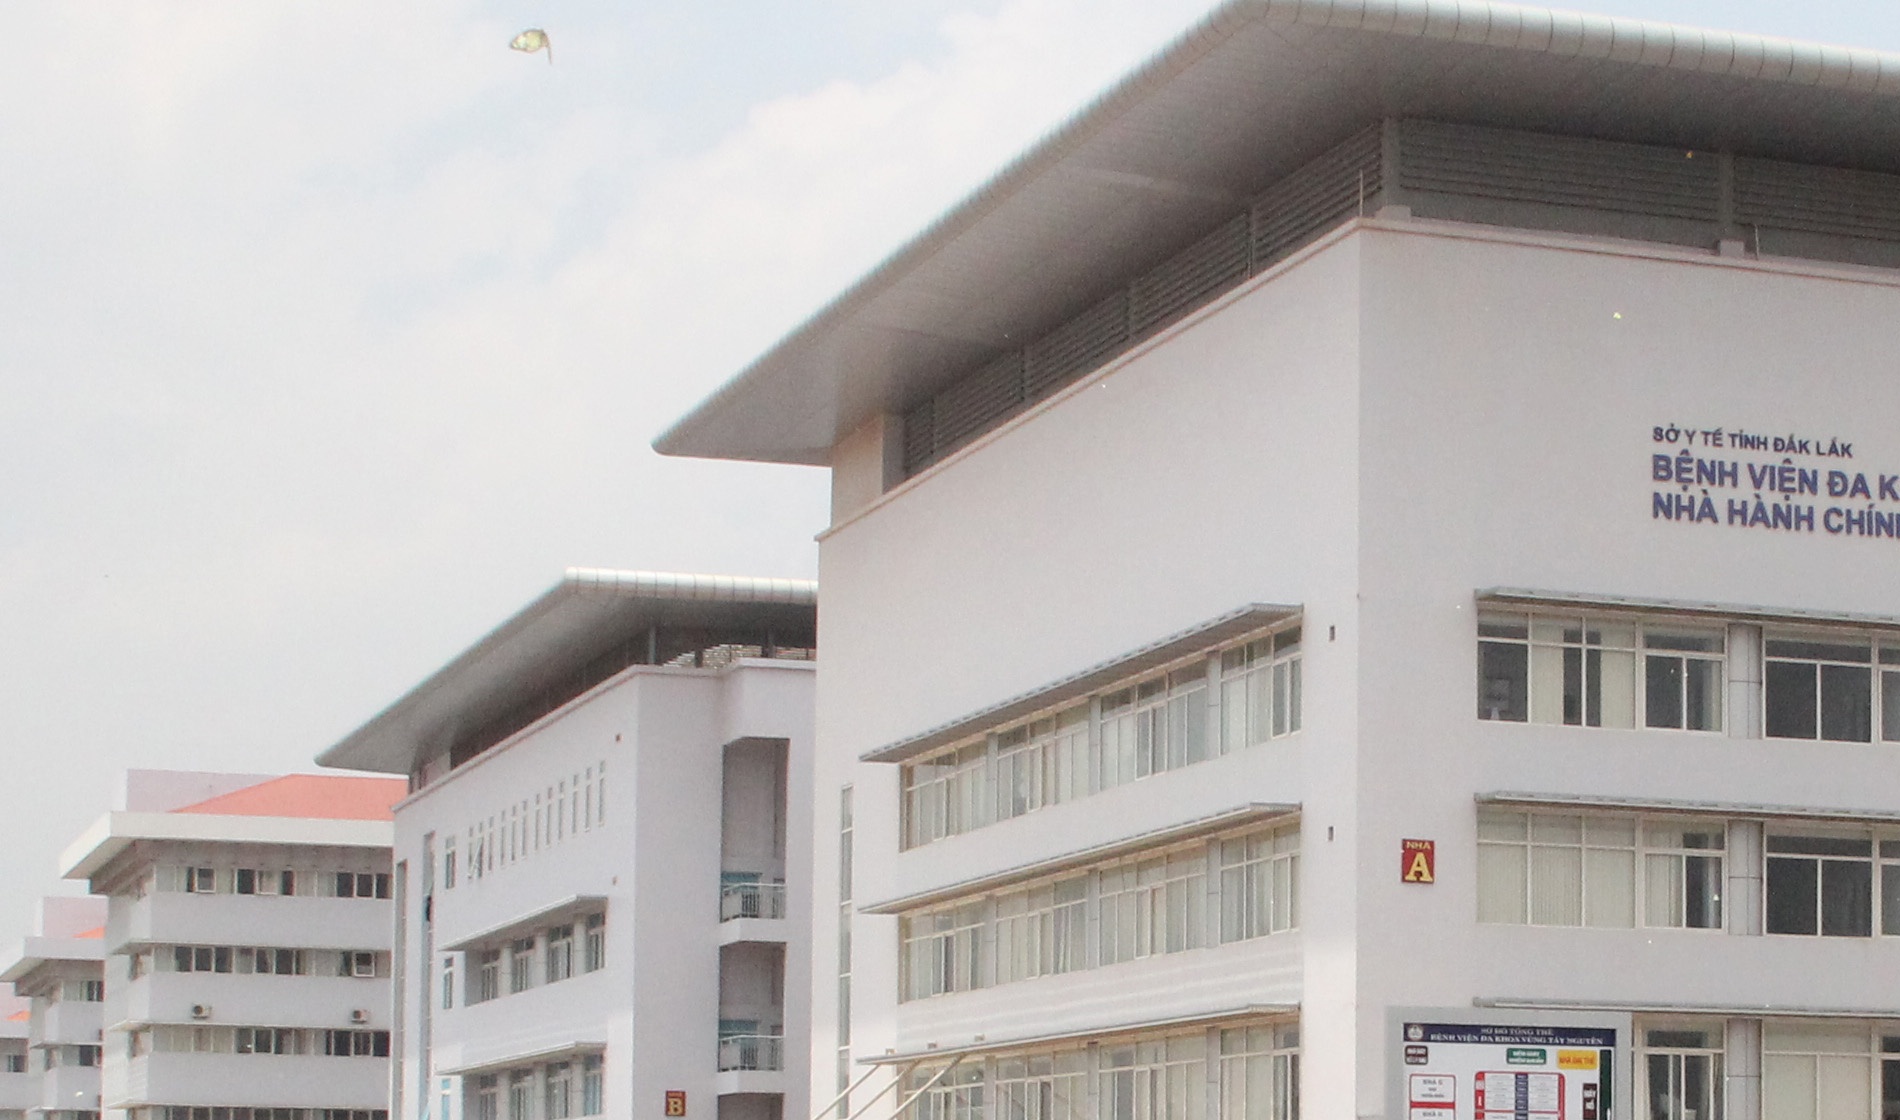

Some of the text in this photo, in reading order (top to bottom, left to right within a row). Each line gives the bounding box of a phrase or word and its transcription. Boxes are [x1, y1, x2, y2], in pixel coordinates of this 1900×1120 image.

[1653, 423, 1680, 443] SỞ
[1685, 429, 1696, 445] Y
[1701, 428, 1724, 447] TẾ
[1652, 449, 1738, 491] BỆNH
[1747, 458, 1818, 501] VIỆN
[1827, 470, 1871, 499] ĐA
[1652, 489, 1719, 524] NHÀ
[1727, 493, 1814, 532] HÀNH
[1405, 852, 1433, 882] A
[667, 1098, 683, 1116] B
